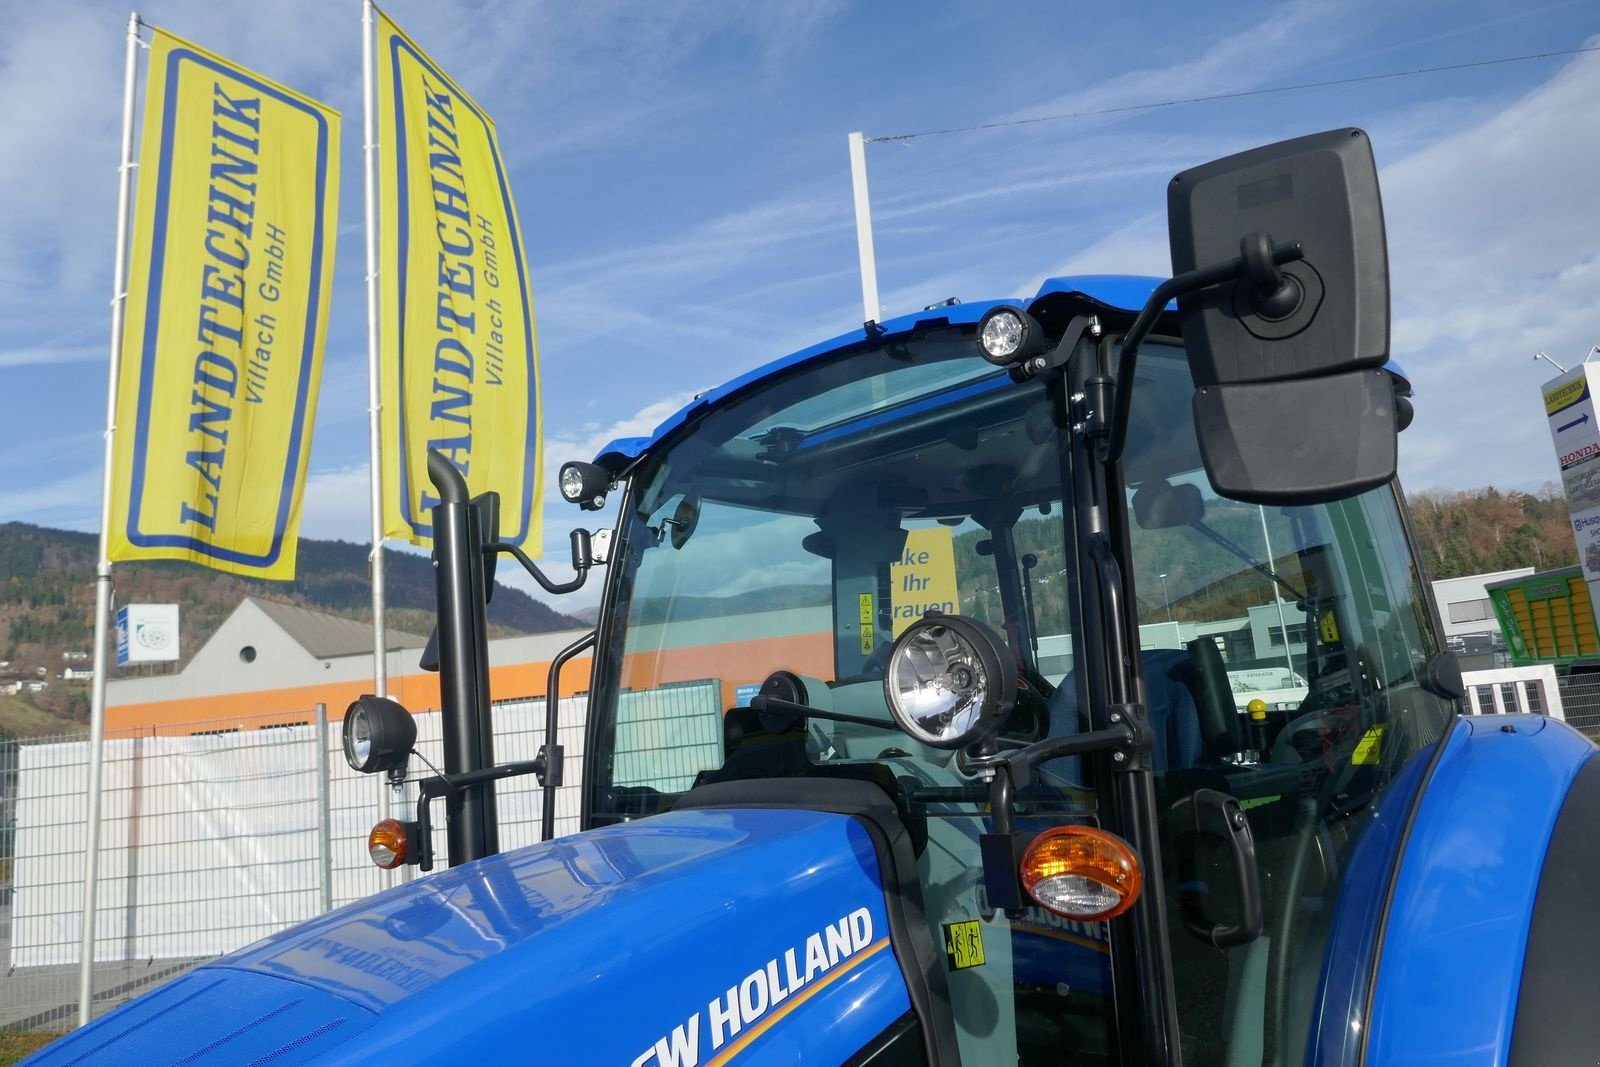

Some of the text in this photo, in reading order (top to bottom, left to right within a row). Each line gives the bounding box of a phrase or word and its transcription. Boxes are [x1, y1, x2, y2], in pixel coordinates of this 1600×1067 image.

[180, 82, 260, 534] LANDTECHNIK
[245, 223, 286, 404] Villach GmbH
[476, 214, 503, 386] Villach GmbH
[1545, 381, 1583, 405] LANDTECHNIK
[1560, 443, 1600, 466] HONDA
[892, 548, 929, 566] ke
[903, 574, 930, 592] Ihr
[708, 906, 874, 1051] HOLLAND
